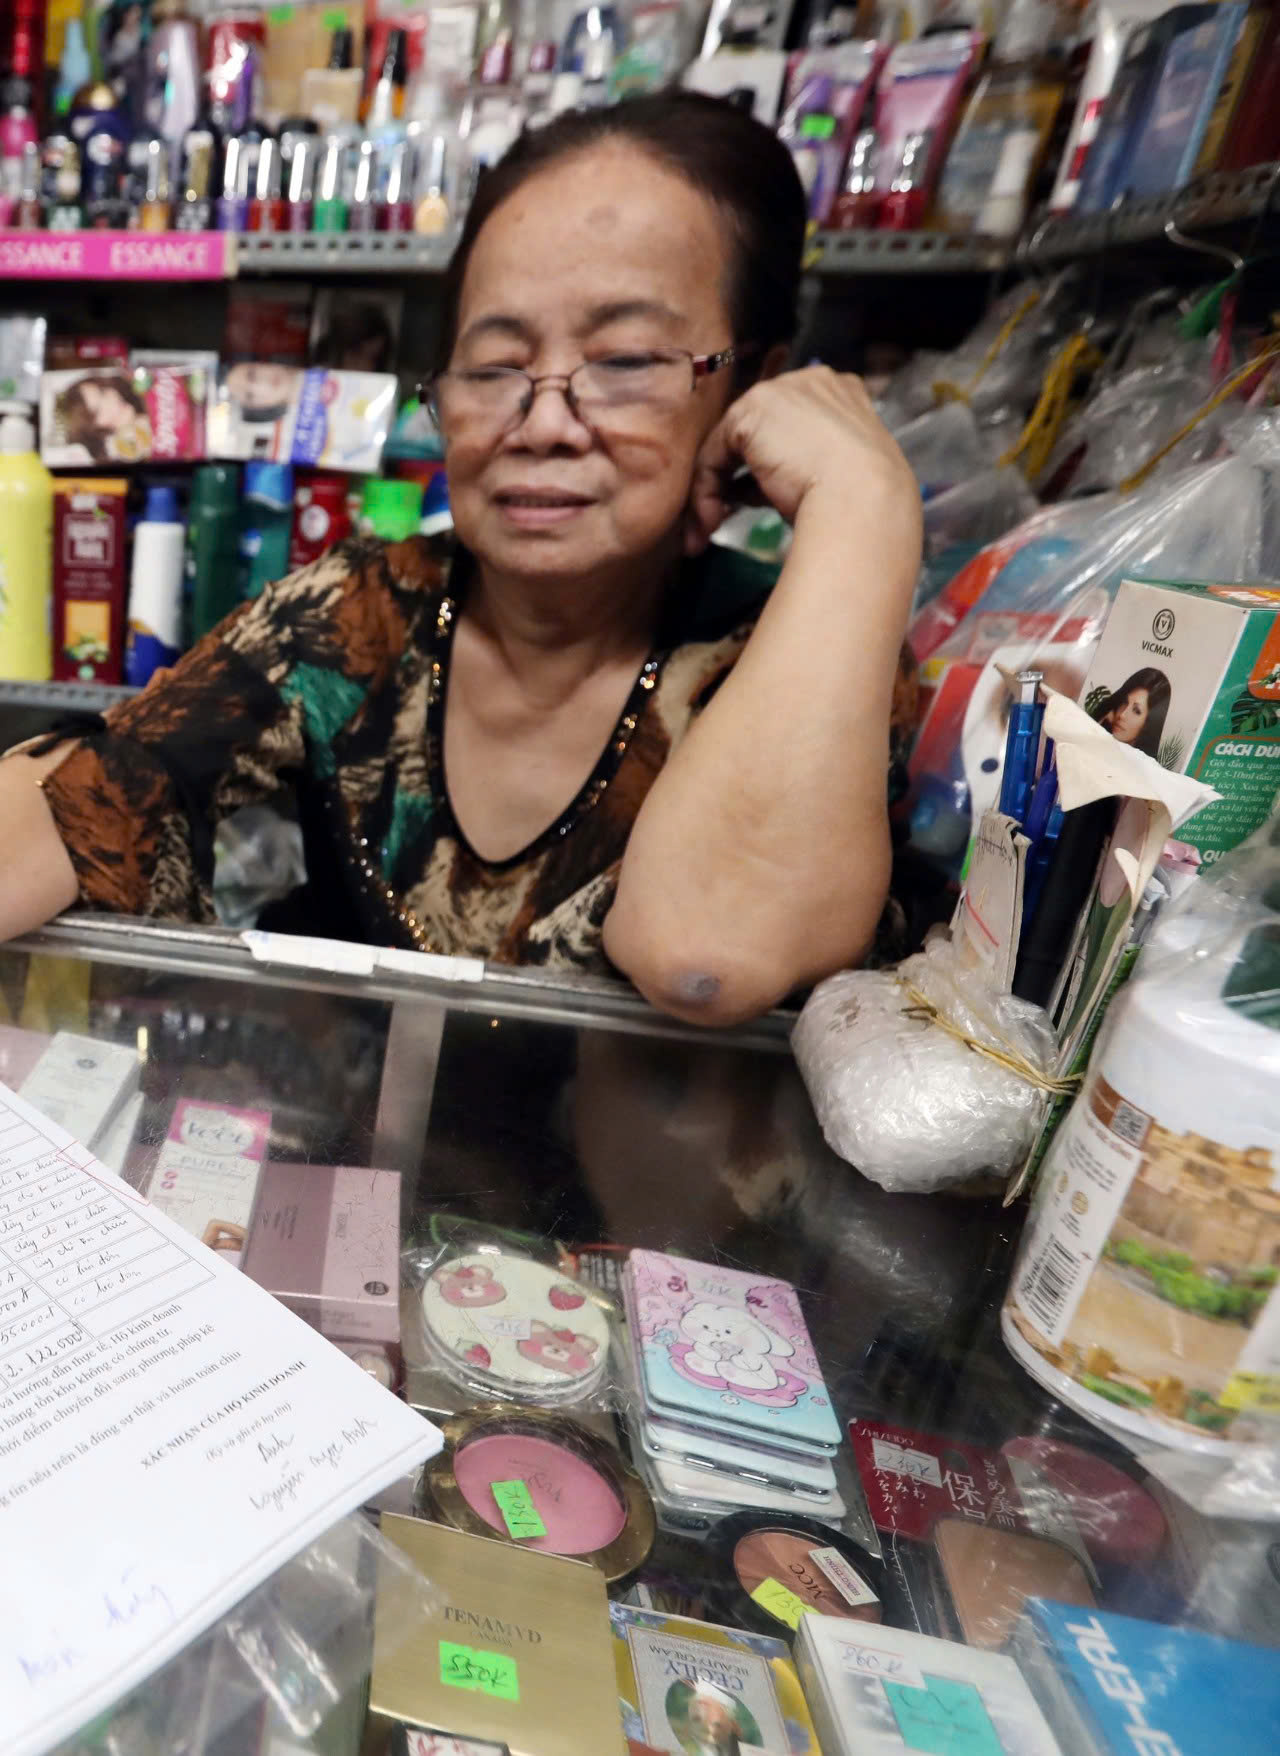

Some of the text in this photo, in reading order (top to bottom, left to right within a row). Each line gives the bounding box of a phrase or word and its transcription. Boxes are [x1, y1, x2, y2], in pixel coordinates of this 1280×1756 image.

[1141, 640, 1173, 658] VICMAX
[1214, 741, 1250, 757] CÁCH
[0, 1395, 14, 1408] và
[111, 1331, 129, 1347] Hộ
[128, 1317, 153, 1336] kinh
[151, 1302, 183, 1324] doanh
[137, 1348, 179, 1376] phương
[176, 1331, 203, 1354] pháp
[51, 1381, 77, 1400] kho
[77, 1364, 111, 1391] không
[140, 1360, 307, 1470] XÁC NHẬN CỦA HỘ KINH DOANH
[789, 1563, 825, 1600] MCC
[445, 1606, 542, 1644] TENAMYD
[649, 1644, 703, 1664] CREAM
[665, 1660, 744, 1692] CECILY
